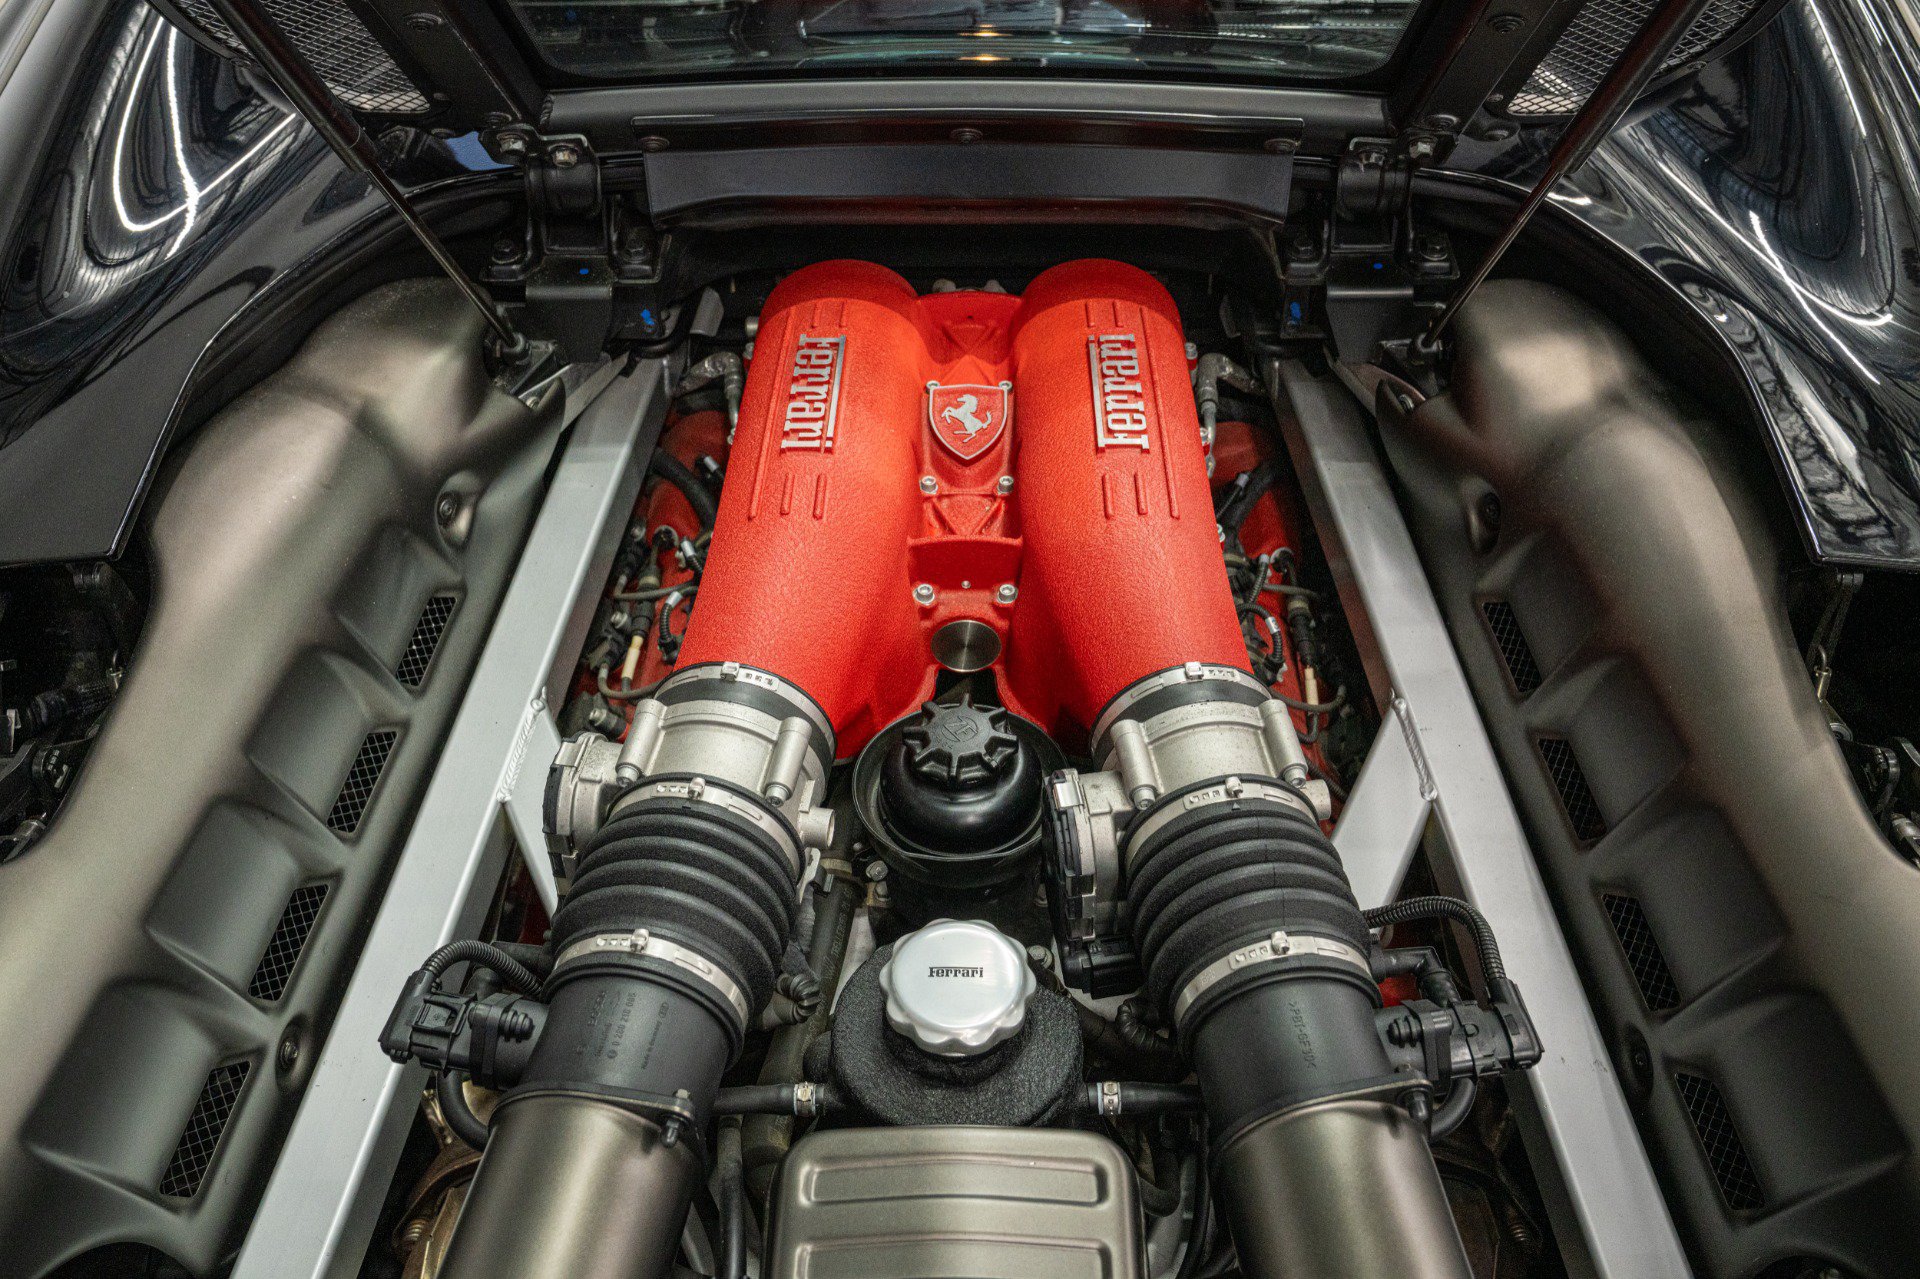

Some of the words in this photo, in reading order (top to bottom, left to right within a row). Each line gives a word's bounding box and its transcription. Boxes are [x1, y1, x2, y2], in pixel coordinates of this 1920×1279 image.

[780, 333, 846, 453] Ferrari
[1086, 334, 1150, 454] Ferrari
[928, 967, 983, 978] Ferrari
